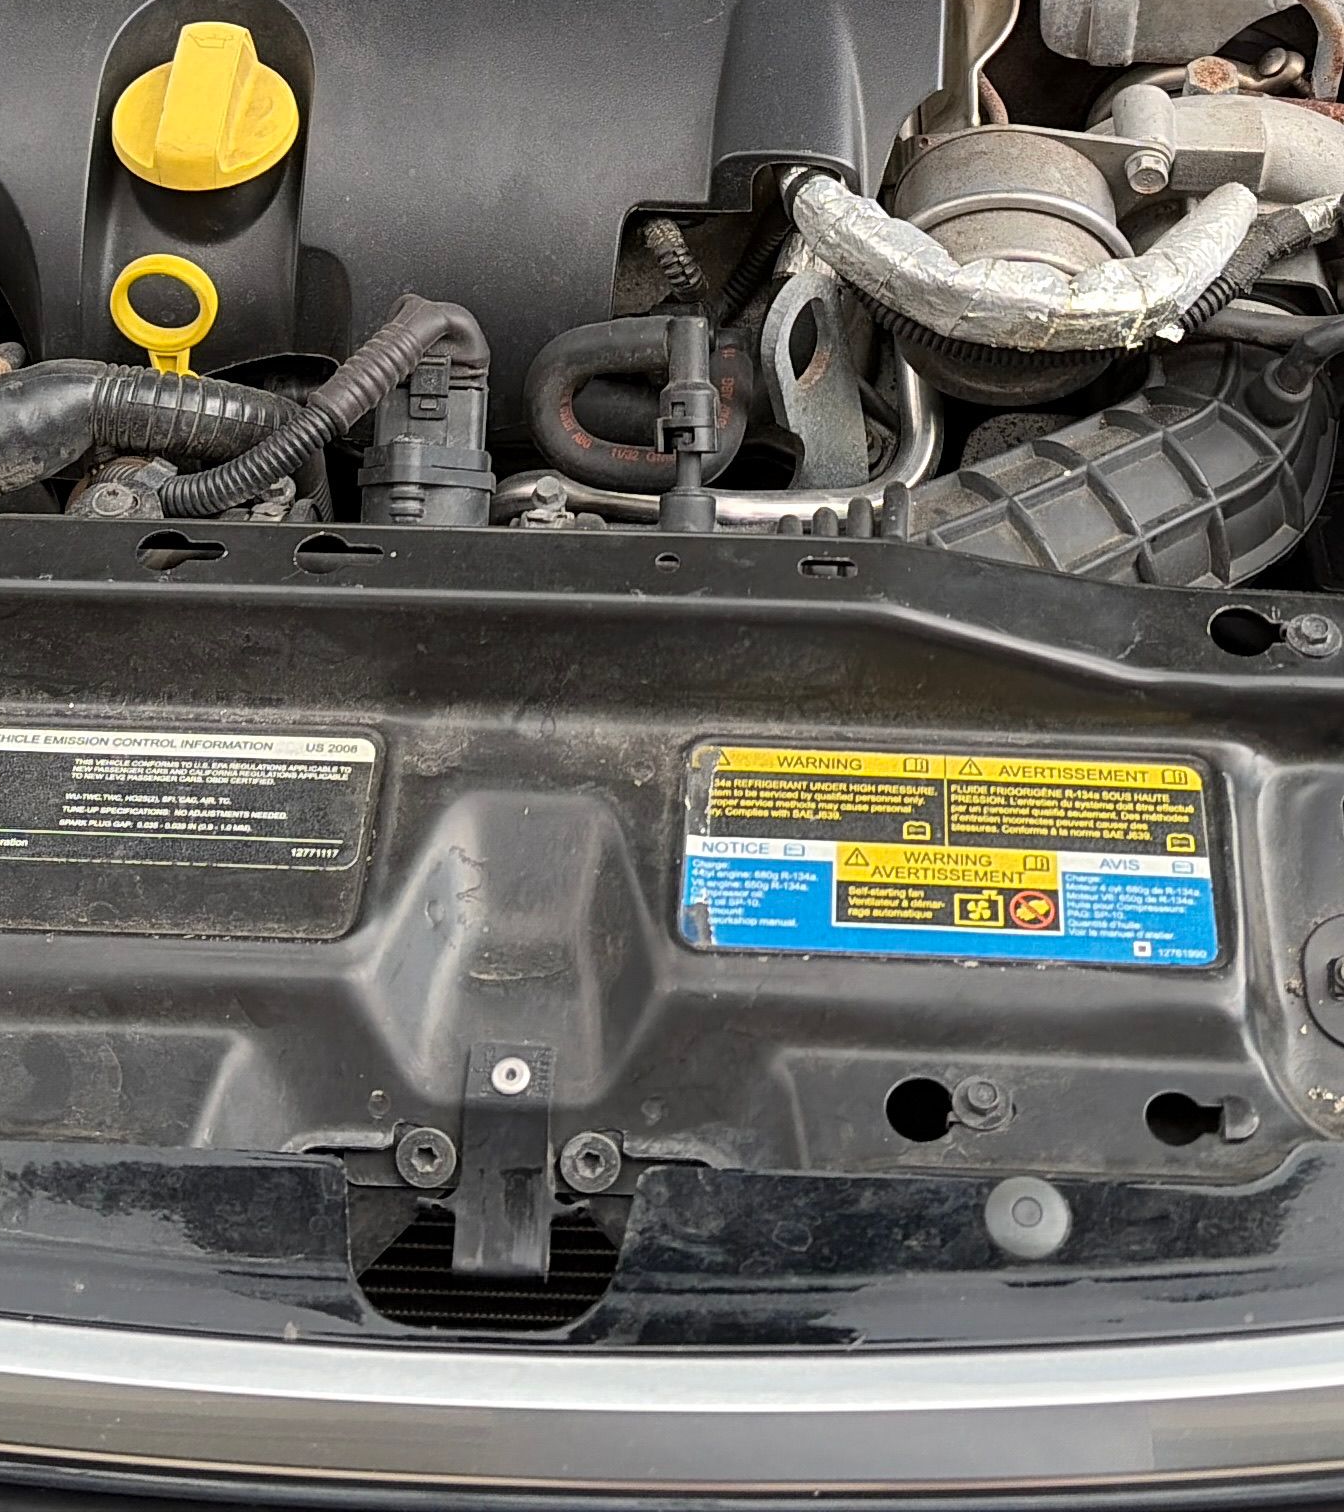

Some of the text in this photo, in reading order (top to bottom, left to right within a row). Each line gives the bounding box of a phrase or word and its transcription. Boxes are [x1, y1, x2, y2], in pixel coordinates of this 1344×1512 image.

[43, 735, 109, 747] EMISSION
[111, 737, 177, 749] CONTROL
[179, 739, 274, 752] INFORMATION
[306, 742, 325, 753] US
[777, 754, 863, 771] WARNING
[999, 765, 1150, 784] AVERTISSEMENT
[734, 779, 937, 796] REFRIGERANT UNDER HIGH PRESSURE.
[951, 784, 988, 796] FLUIDE
[1065, 789, 1100, 800] R-134a
[1102, 791, 1131, 801] SOUS
[1134, 792, 1170, 803] HAUTE
[701, 840, 770, 855] NOTICE
[903, 850, 992, 868] WARNING
[1099, 858, 1141, 872] AVIS
[870, 865, 1025, 885] AVERTISSEMENT
[848, 886, 924, 899] Self-starting fan
[848, 896, 900, 907] Ventilateur
[848, 907, 933, 920] rage automatique
